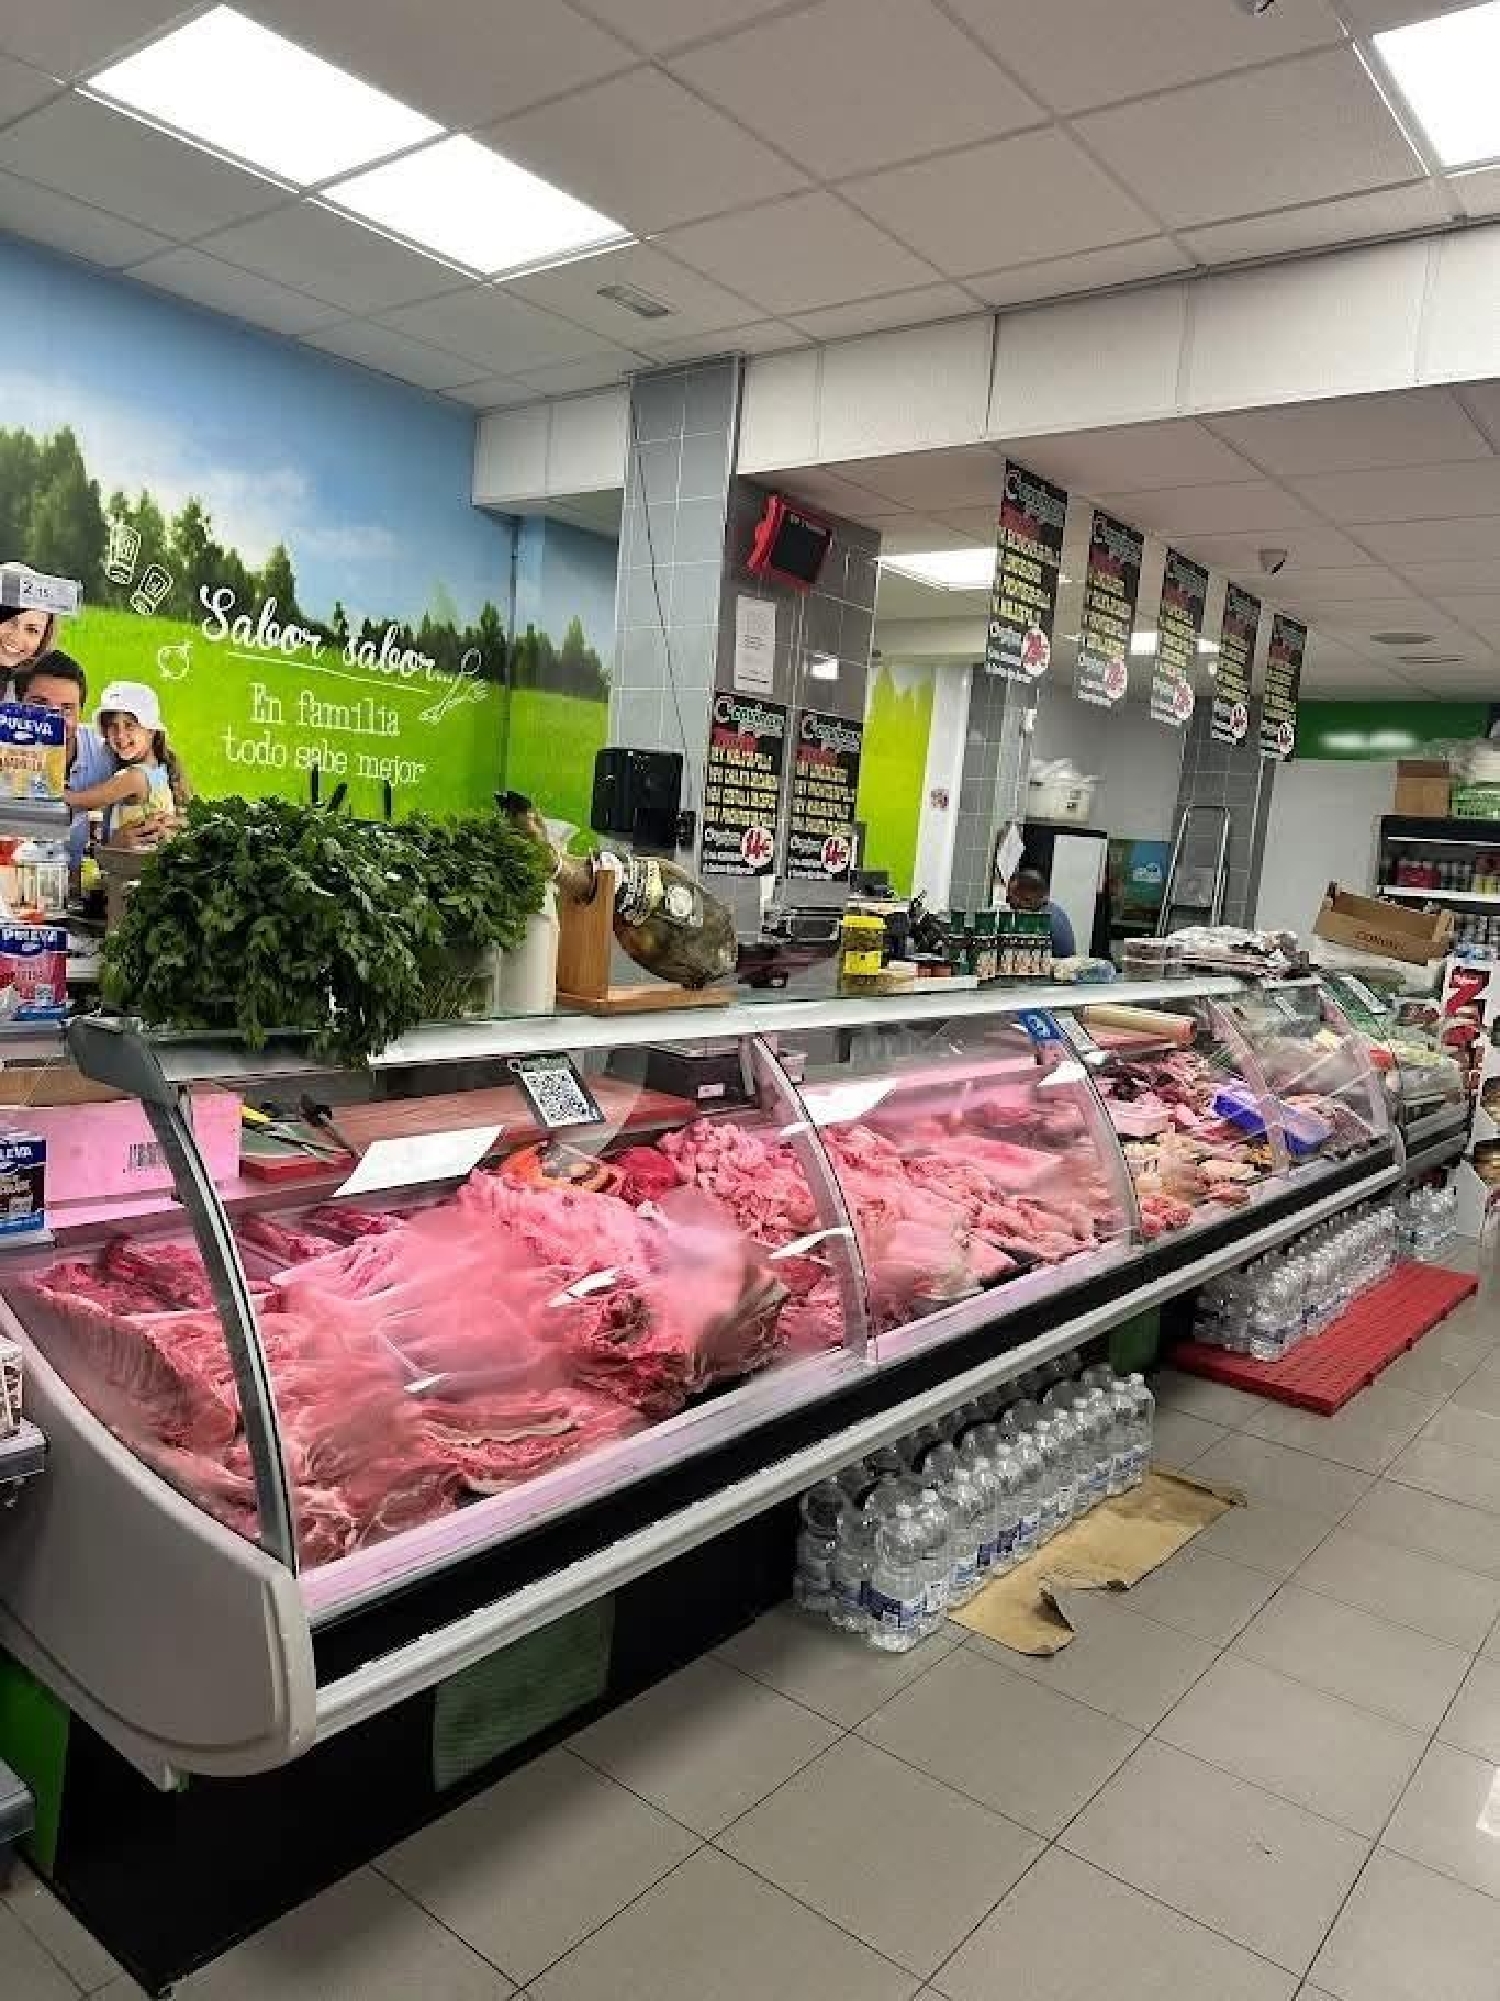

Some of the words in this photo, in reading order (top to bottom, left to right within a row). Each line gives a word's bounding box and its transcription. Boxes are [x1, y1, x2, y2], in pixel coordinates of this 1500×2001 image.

[199, 583, 326, 660] Sabor
[250, 682, 283, 726] En
[297, 689, 401, 737] familia
[221, 724, 287, 769] todo
[295, 737, 348, 774] sabe
[355, 751, 427, 787] mejor
